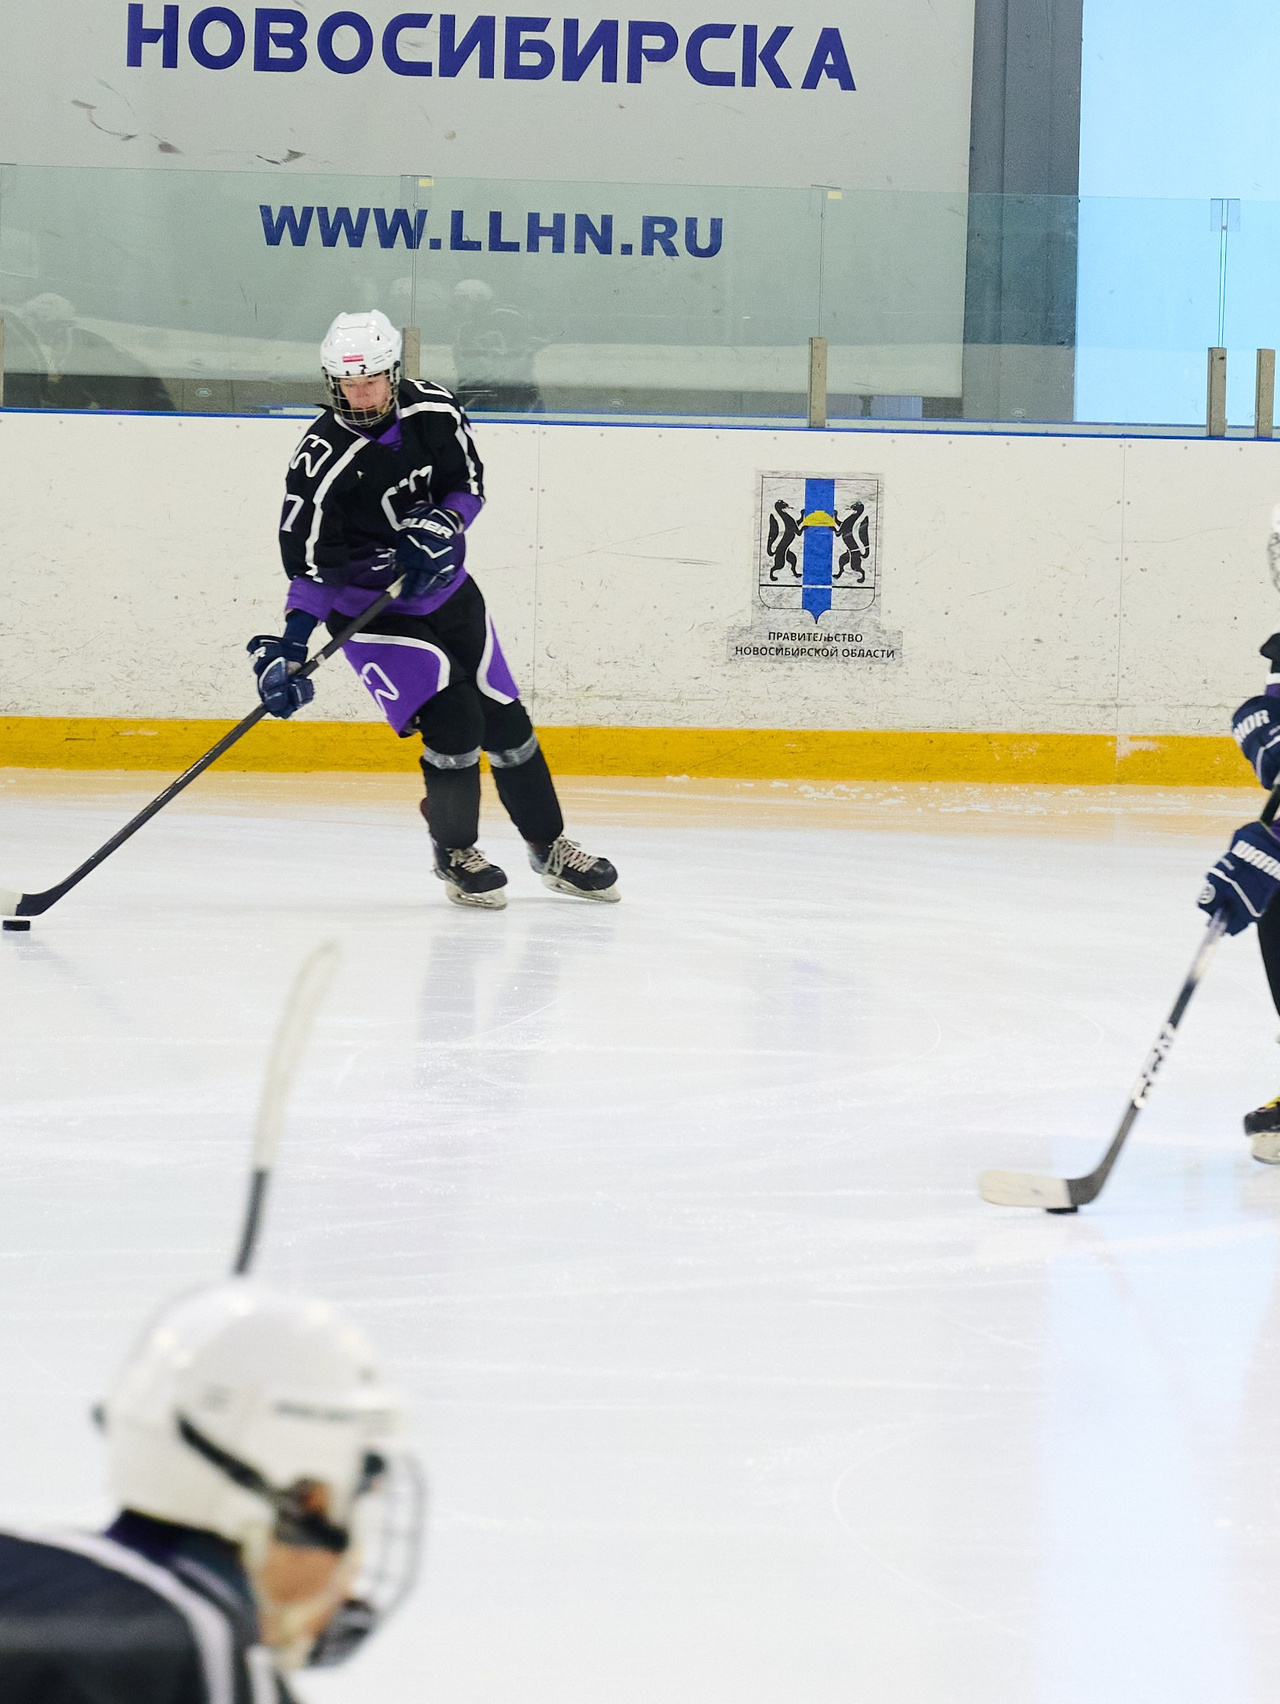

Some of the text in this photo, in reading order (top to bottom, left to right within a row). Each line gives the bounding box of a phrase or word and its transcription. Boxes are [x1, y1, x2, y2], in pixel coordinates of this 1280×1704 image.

[126, 3, 857, 91] НОВОСИБИРСКА
[259, 205, 723, 258] WWW.LLHN.RU
[735, 646, 896, 659] НОВОСИБИРСКОЙ ОБЛАСТИ
[768, 631, 863, 643] ПРАВИТЕЛЬСТВО
